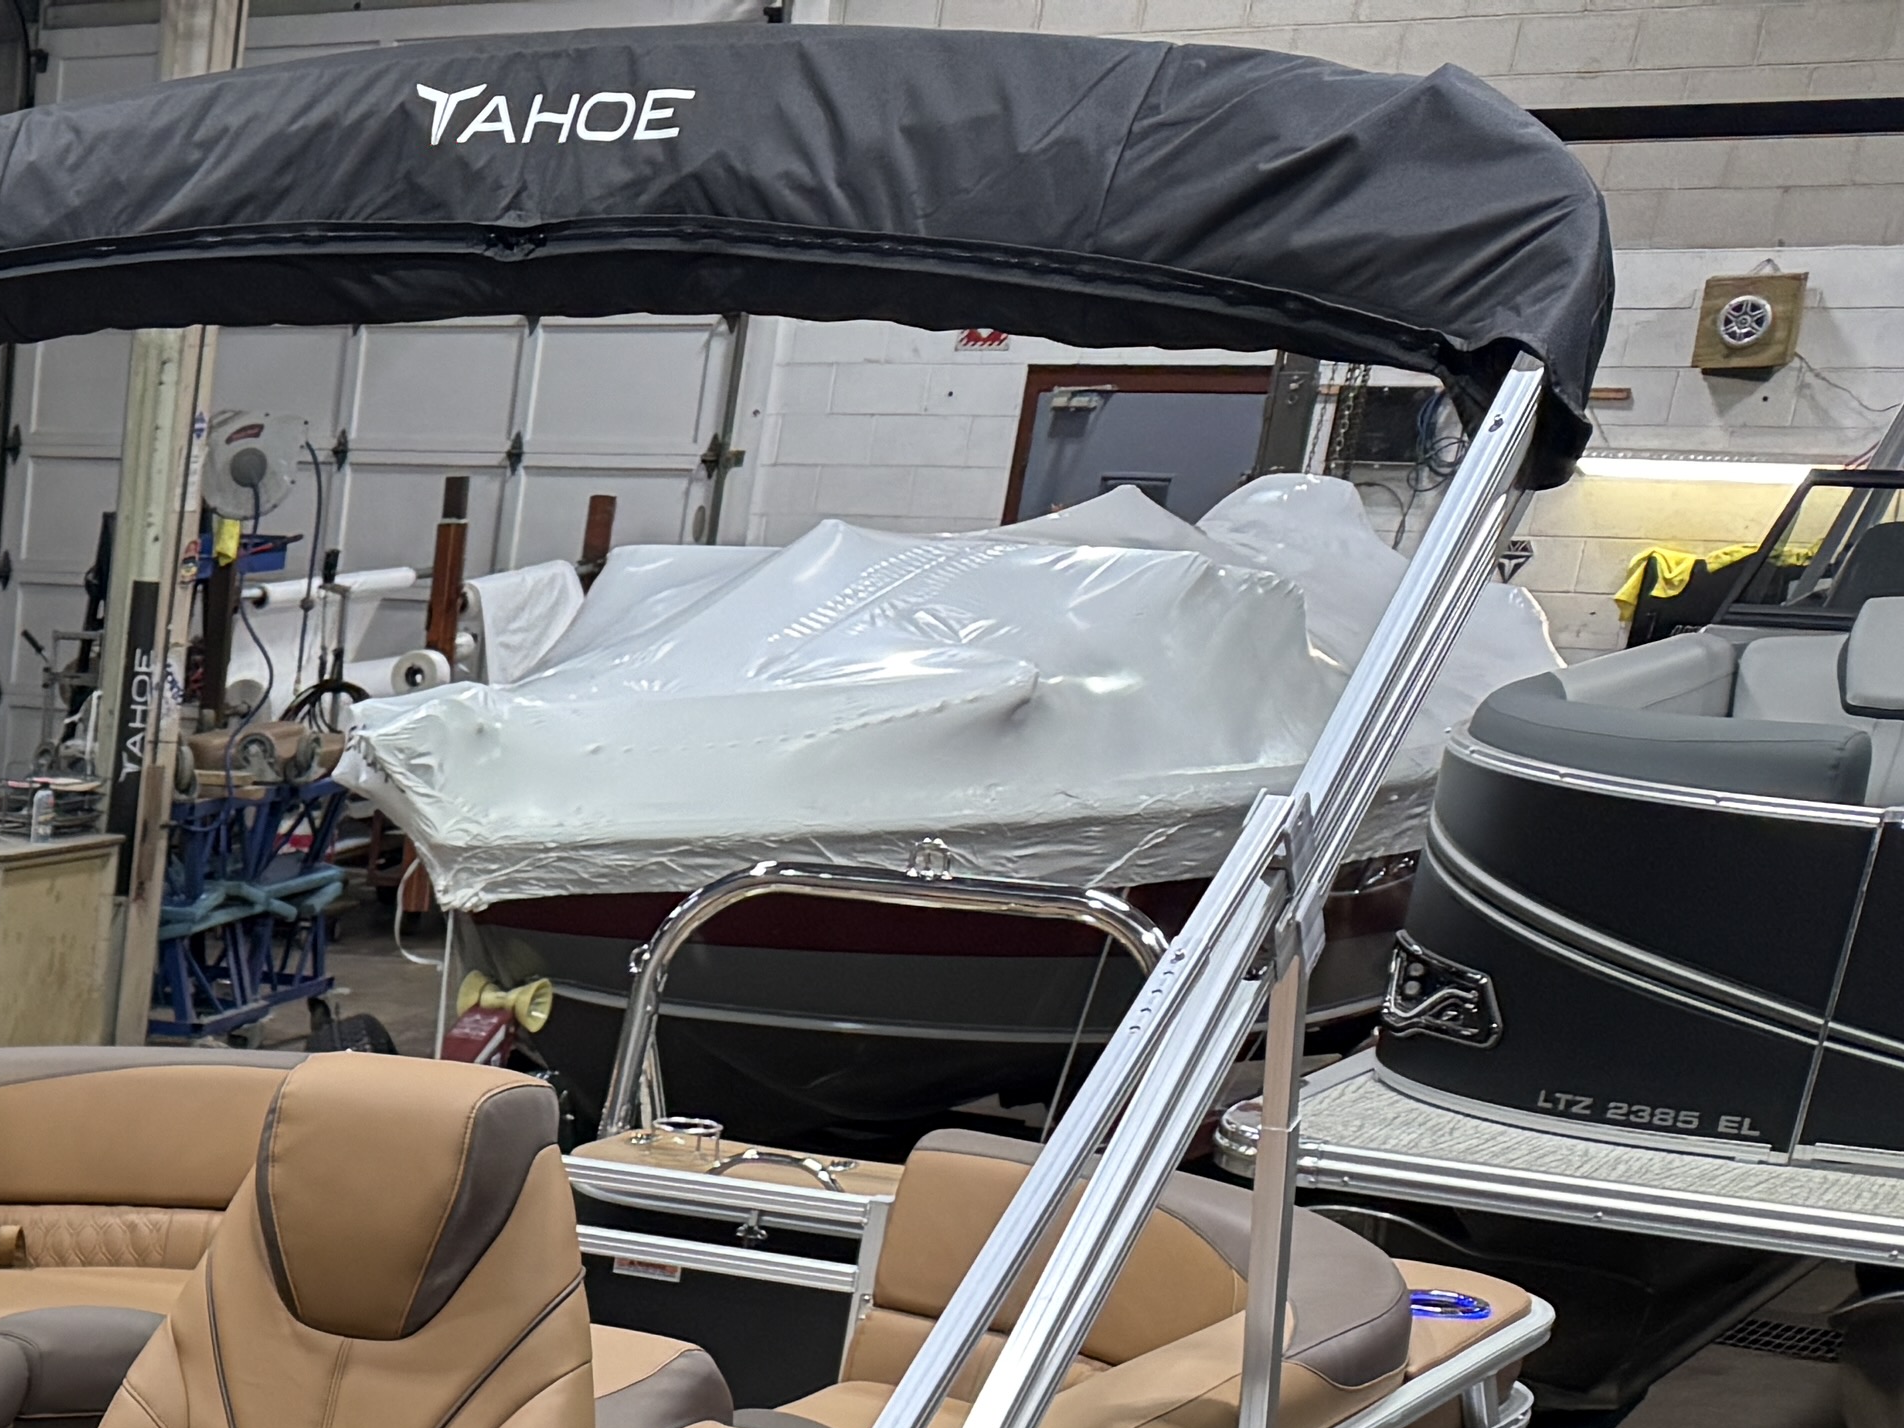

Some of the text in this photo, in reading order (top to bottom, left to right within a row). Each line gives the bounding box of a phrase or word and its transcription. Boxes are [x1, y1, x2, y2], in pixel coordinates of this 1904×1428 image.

[416, 83, 696, 146] TAHOE
[119, 648, 155, 783] TAHOE
[1537, 1089, 1761, 1137] LTZ 2385 EL
